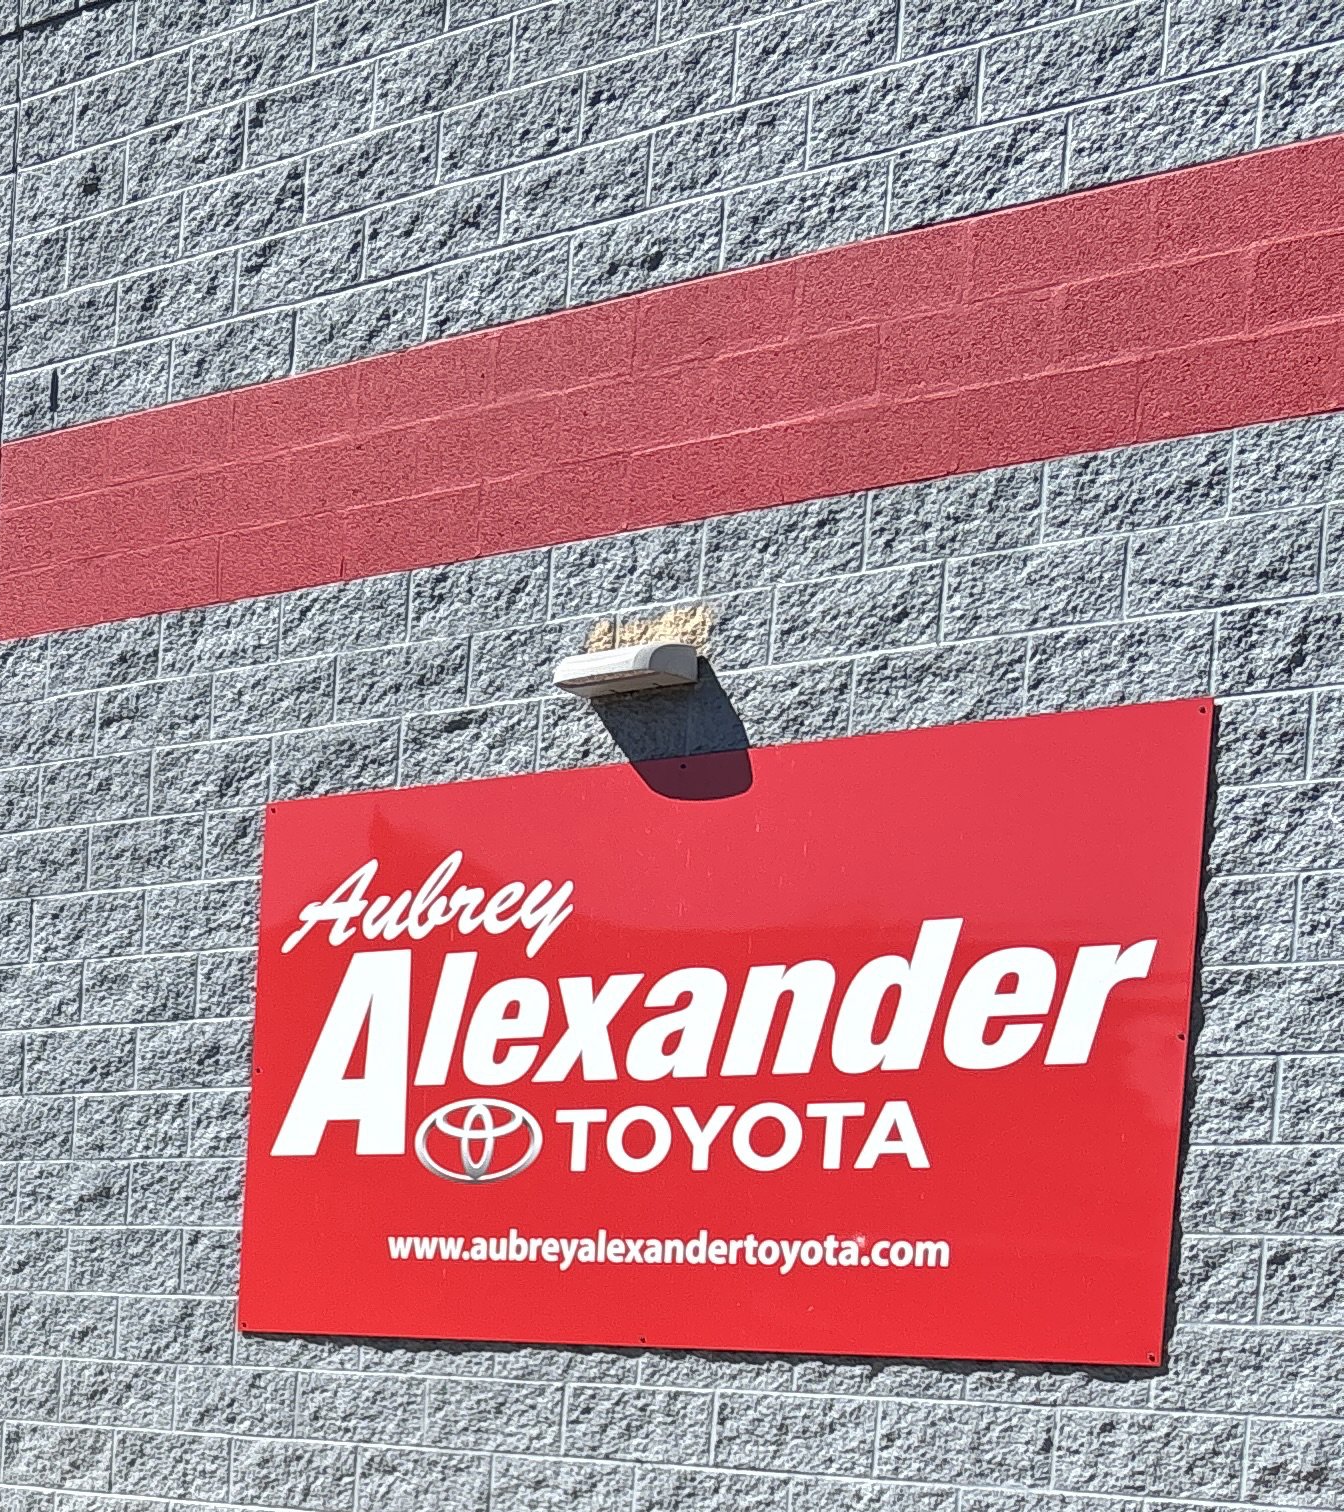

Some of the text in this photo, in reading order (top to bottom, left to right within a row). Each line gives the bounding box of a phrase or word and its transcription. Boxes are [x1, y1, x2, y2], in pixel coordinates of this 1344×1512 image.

[280, 850, 575, 959] Aubrey
[269, 916, 1159, 1158] Alexander
[554, 1100, 932, 1173] TOYOTA
[387, 1228, 951, 1276] www.aubreyalexandertoyota.com
